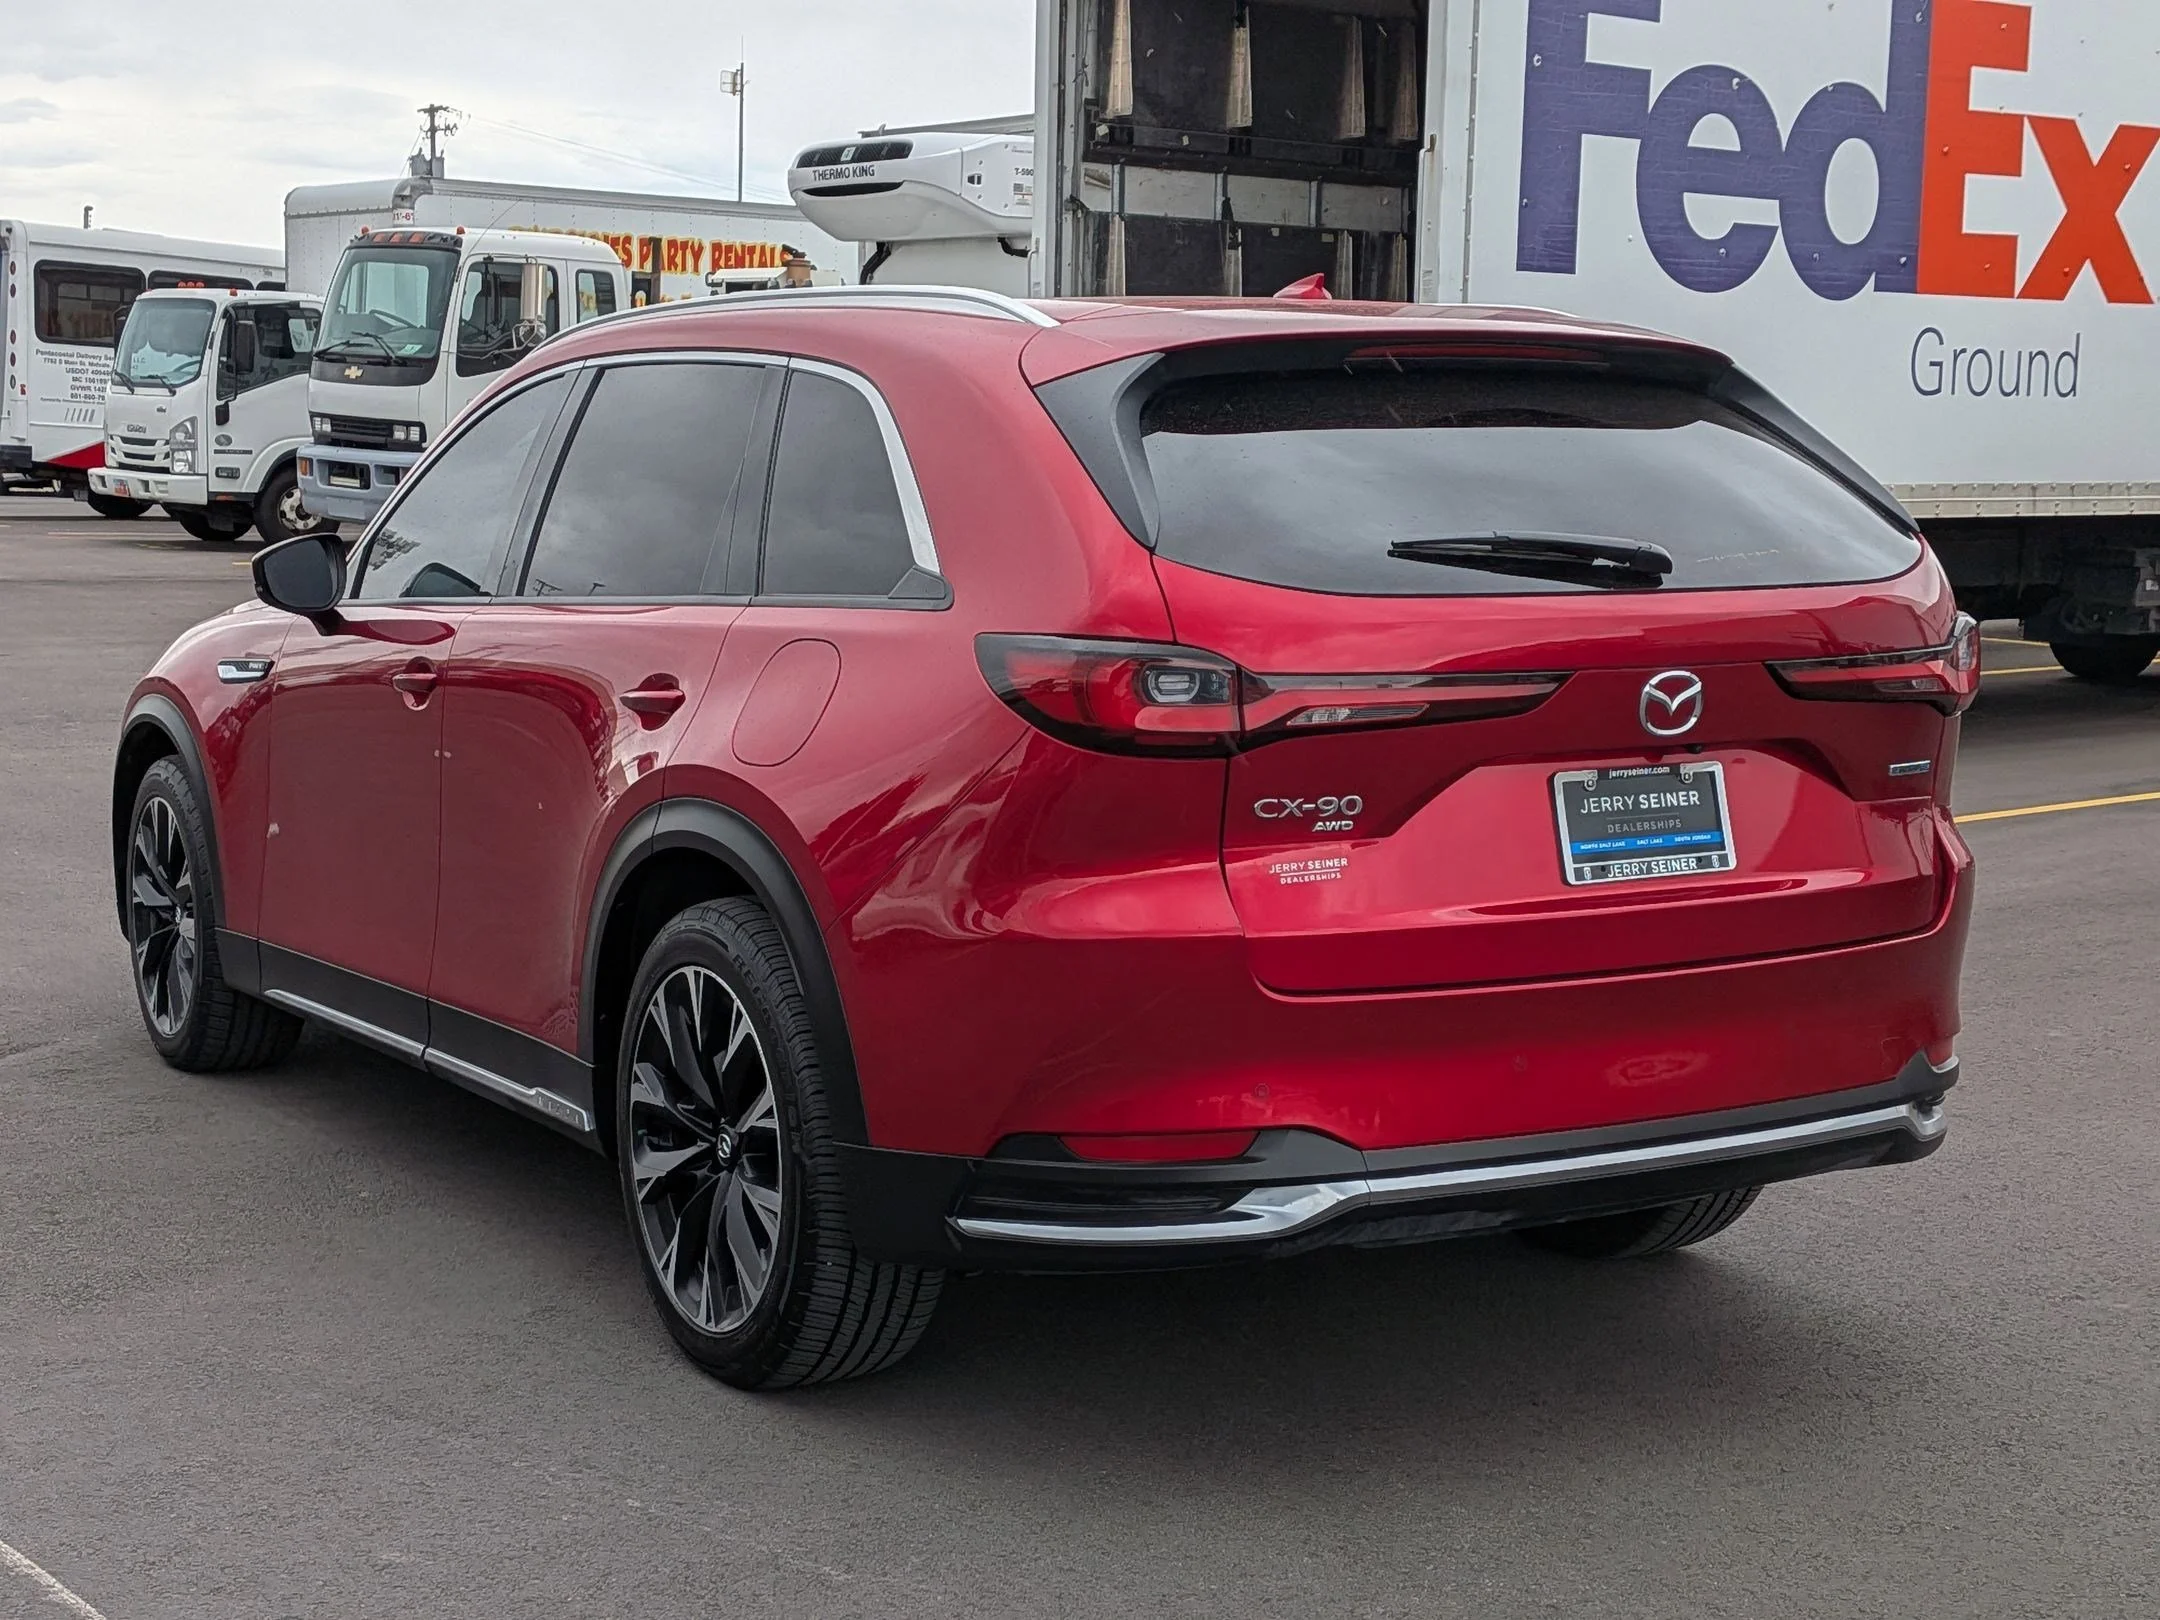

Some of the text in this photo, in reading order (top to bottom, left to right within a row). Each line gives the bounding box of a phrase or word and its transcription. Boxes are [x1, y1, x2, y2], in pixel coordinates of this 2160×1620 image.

[1516, 0, 2160, 305] FedEx
[812, 164, 875, 182] THERMO KING
[65, 367, 89, 375] USDOT
[1911, 327, 2081, 398] Ground
[1609, 766, 1670, 779] jerryseiner.com
[1254, 795, 1363, 818] CX-90
[1580, 791, 1700, 814] JERRY SEINER
[1312, 820, 1354, 832] AWD
[1607, 818, 1682, 834] DEALERSHIPS
[1268, 857, 1349, 874] JERRY SEINER
[1607, 857, 1698, 878] JERRY SEINER
[1280, 872, 1342, 885] DEALERSHIPS
